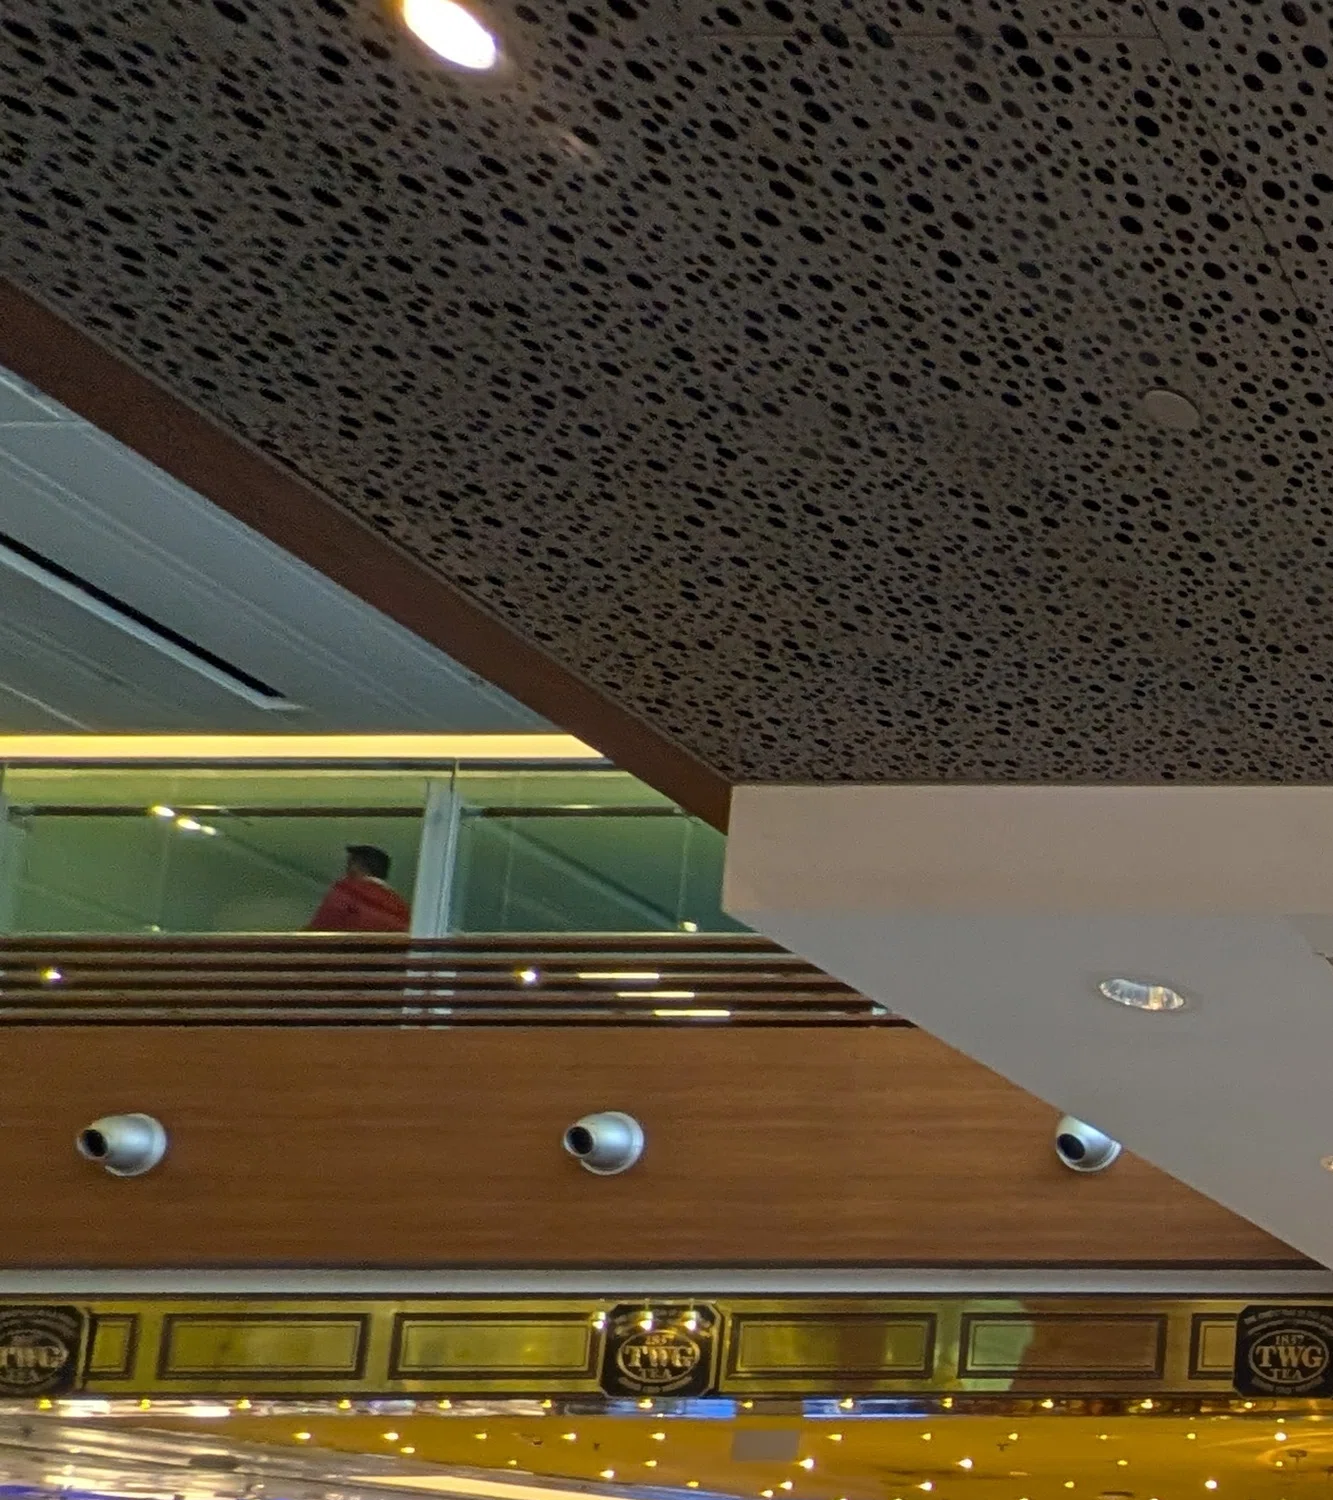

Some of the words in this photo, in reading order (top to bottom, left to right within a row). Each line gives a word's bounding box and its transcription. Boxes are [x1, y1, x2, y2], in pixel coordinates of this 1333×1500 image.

[624, 1345, 694, 1368] TWG
[1255, 1346, 1323, 1369] TWG
[639, 1368, 672, 1380] TEA
[1270, 1368, 1303, 1380] TEA
